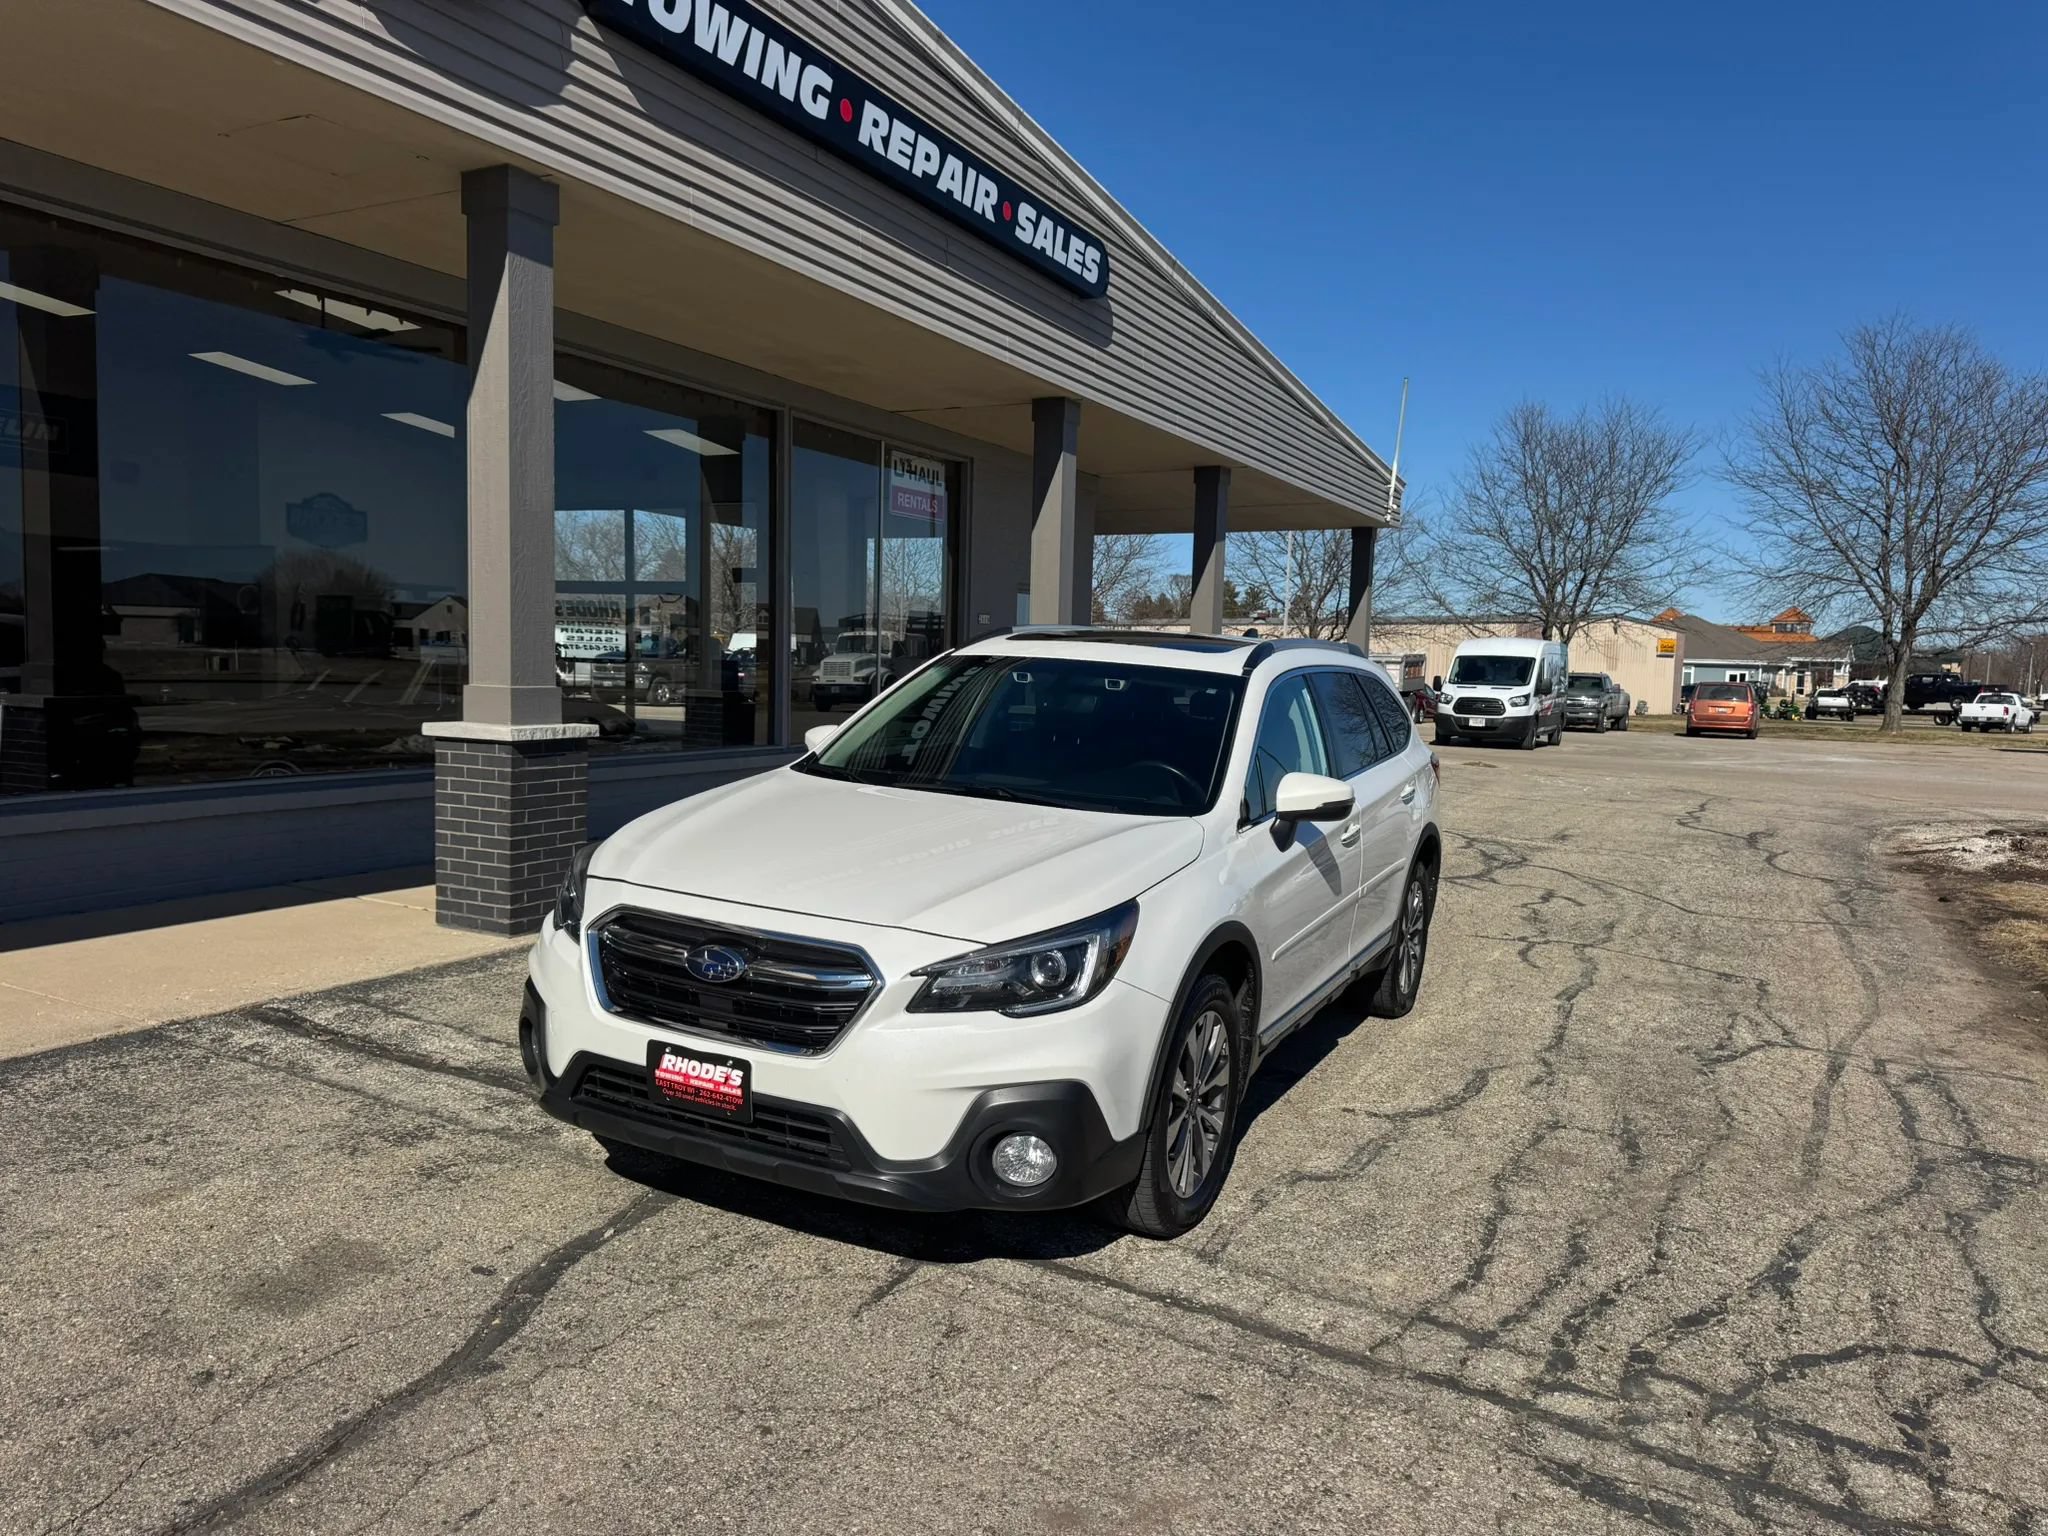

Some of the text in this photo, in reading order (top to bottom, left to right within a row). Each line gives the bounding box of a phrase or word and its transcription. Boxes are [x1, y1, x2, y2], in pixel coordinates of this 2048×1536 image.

[621, 0, 1101, 285] OWING REPAIR SALES
[897, 492, 938, 513] RENTALS
[660, 1053, 744, 1087] RHODE'S
[655, 1079, 670, 1088] EAST
[671, 1082, 687, 1092] TROY
